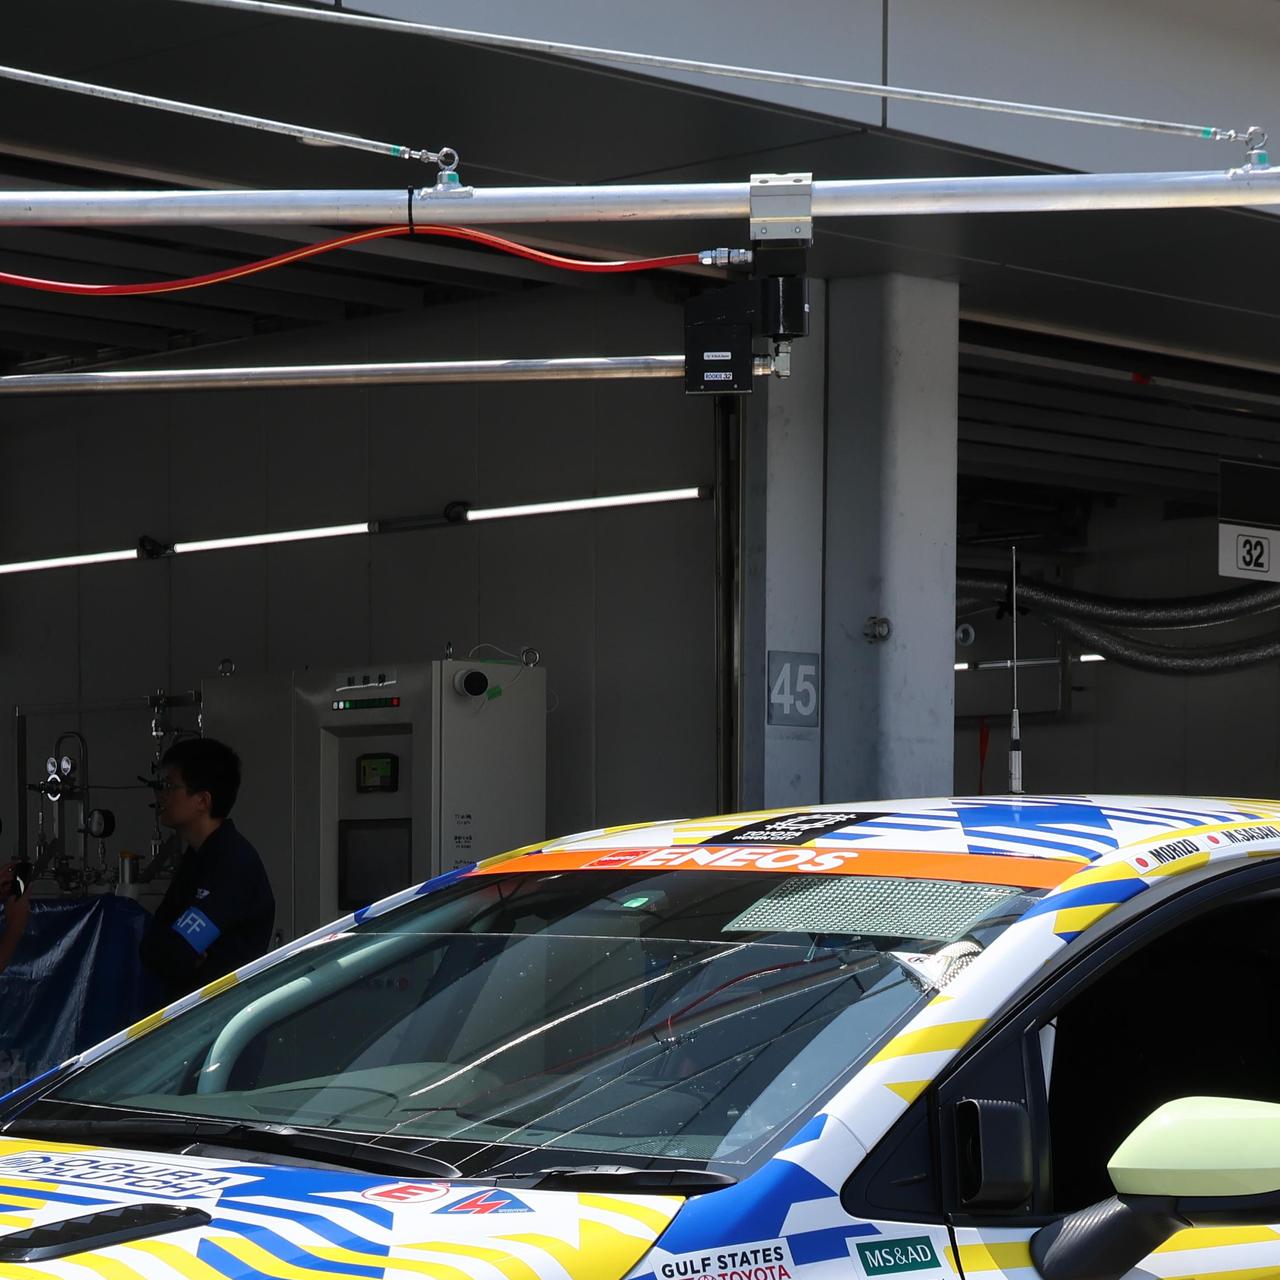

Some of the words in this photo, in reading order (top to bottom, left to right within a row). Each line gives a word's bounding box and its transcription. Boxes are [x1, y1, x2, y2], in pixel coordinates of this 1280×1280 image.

[1242, 539, 1265, 569] 32
[770, 662, 817, 717] 45
[628, 846, 860, 872] ENEOS
[1152, 837, 1201, 865] MORIZO
[16, 1166, 204, 1195] CLUTCH
[51, 1158, 232, 1185] OGURA
[661, 1256, 712, 1279] GULF
[717, 1246, 785, 1269] STATES
[864, 1243, 932, 1269] MS&AD
